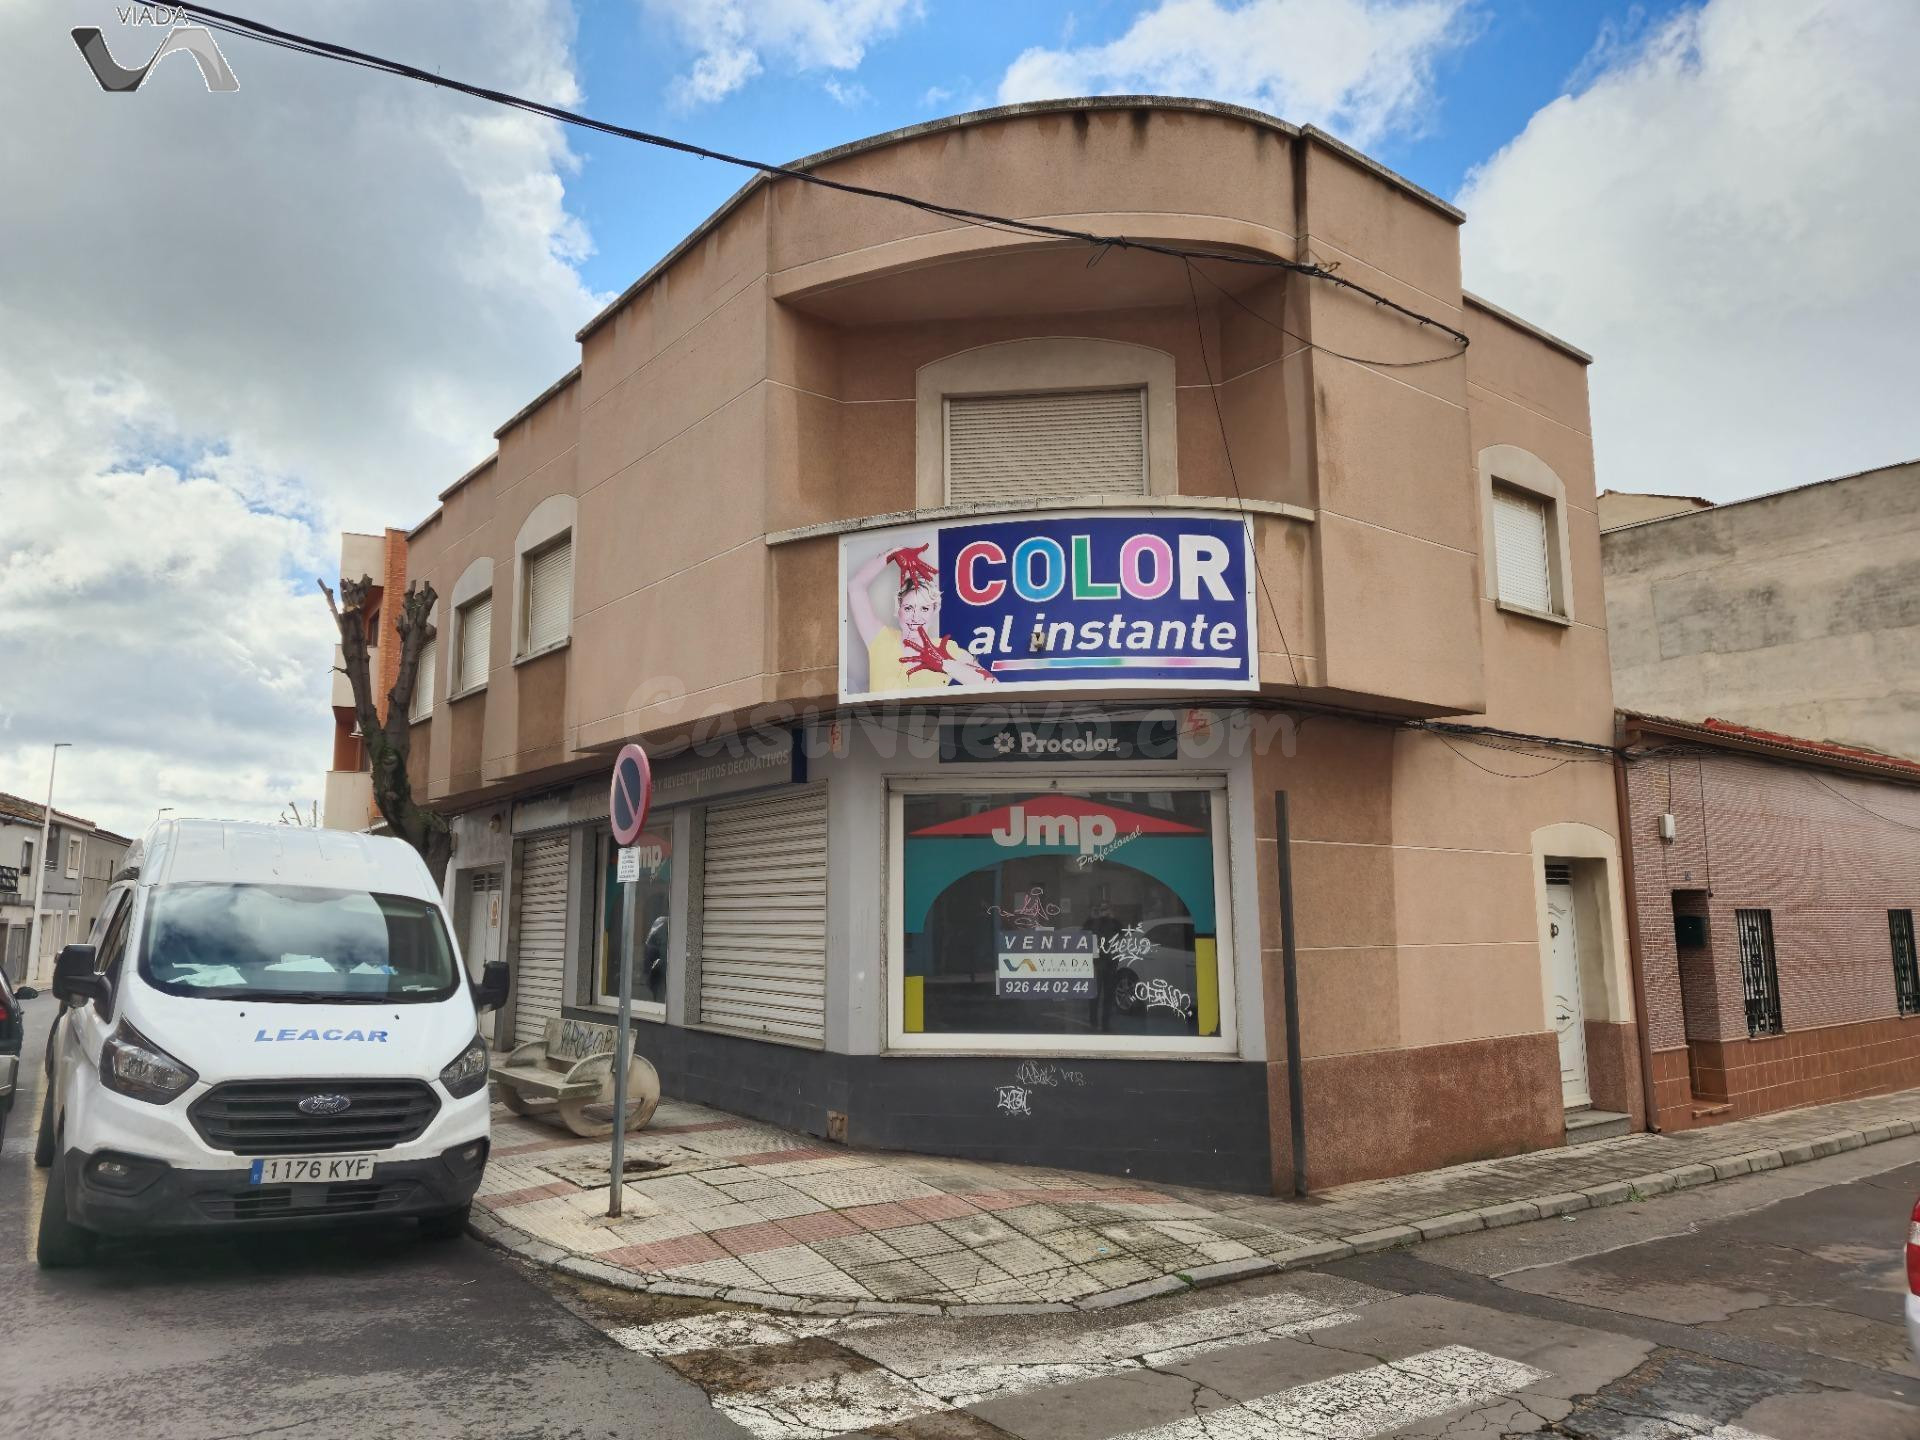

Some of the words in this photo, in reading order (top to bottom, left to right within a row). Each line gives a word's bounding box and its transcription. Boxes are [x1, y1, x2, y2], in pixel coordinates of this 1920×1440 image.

[955, 534, 1235, 607] COLOR
[968, 615, 1014, 656] al
[1030, 613, 1237, 652] instante
[1020, 730, 1119, 753] Procolor
[727, 750, 790, 777] DECORATIVOS
[991, 806, 1117, 855] Jmp
[1004, 935, 1089, 950] VENTA
[1039, 958, 1089, 968] VIADA
[1005, 981, 1030, 994] 926
[1033, 981, 1049, 993] 44
[1052, 981, 1069, 993] 02
[1072, 981, 1089, 993] 44
[254, 1028, 388, 1043] LEACAR
[271, 1160, 322, 1179] 1176
[328, 1158, 369, 1178] KYF
